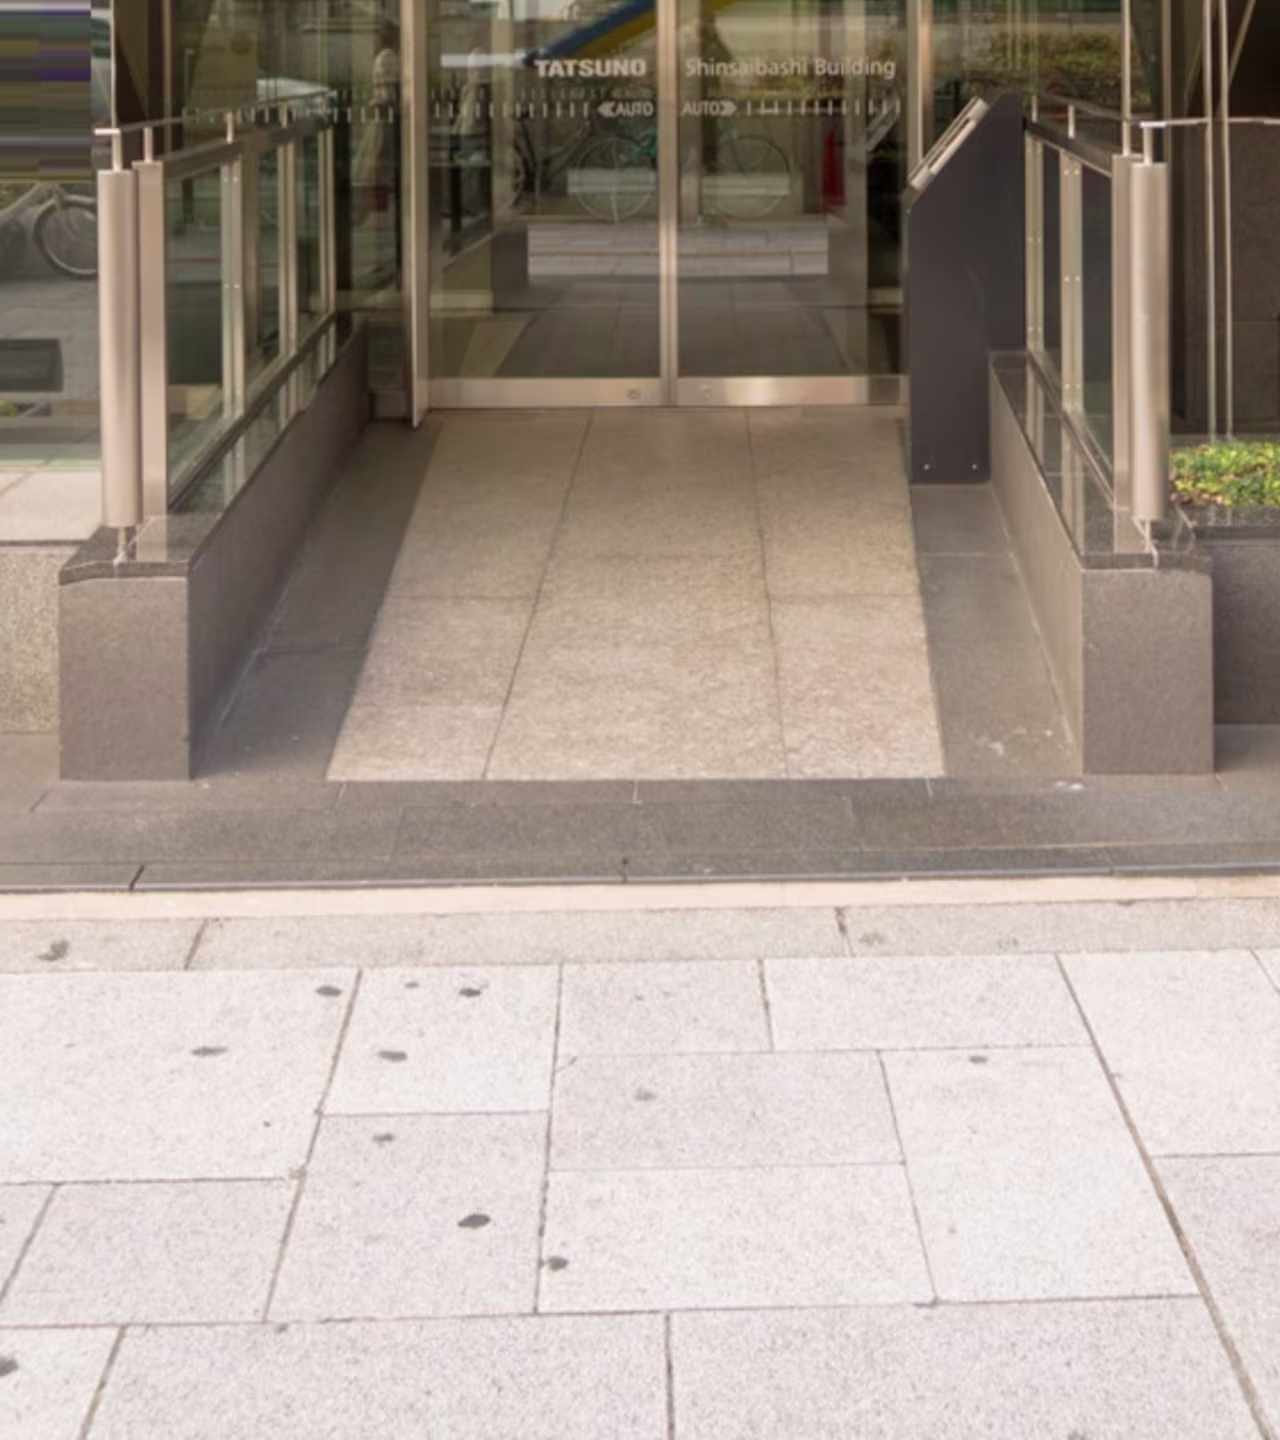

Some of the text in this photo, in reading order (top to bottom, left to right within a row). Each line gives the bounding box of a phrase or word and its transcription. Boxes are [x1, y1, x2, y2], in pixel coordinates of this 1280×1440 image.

[533, 58, 897, 80] TATSUNO Shinsaibashi Building
[615, 101, 654, 117] AUTO
[680, 101, 719, 116] AUTO
